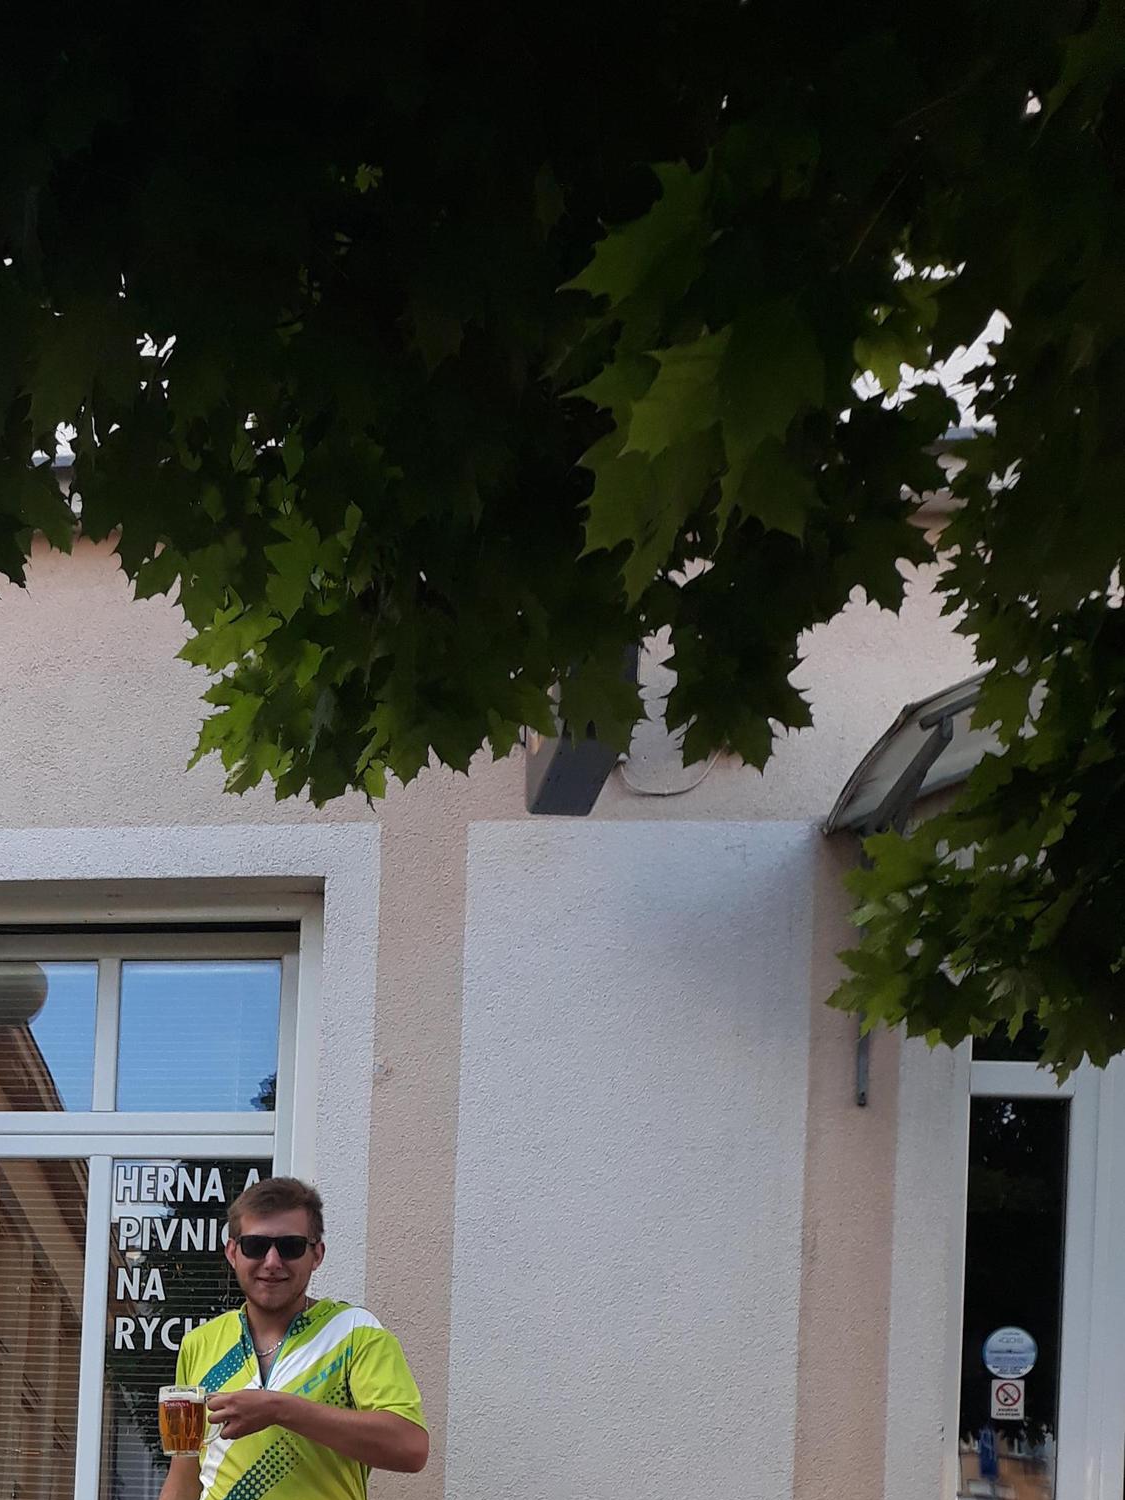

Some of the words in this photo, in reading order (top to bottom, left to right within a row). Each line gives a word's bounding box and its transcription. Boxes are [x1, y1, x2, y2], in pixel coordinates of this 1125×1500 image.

[115, 1166, 225, 1202] HERNA
[118, 1217, 229, 1251] PIVNI
[116, 1267, 166, 1300] NA
[114, 1317, 209, 1351] RYC
